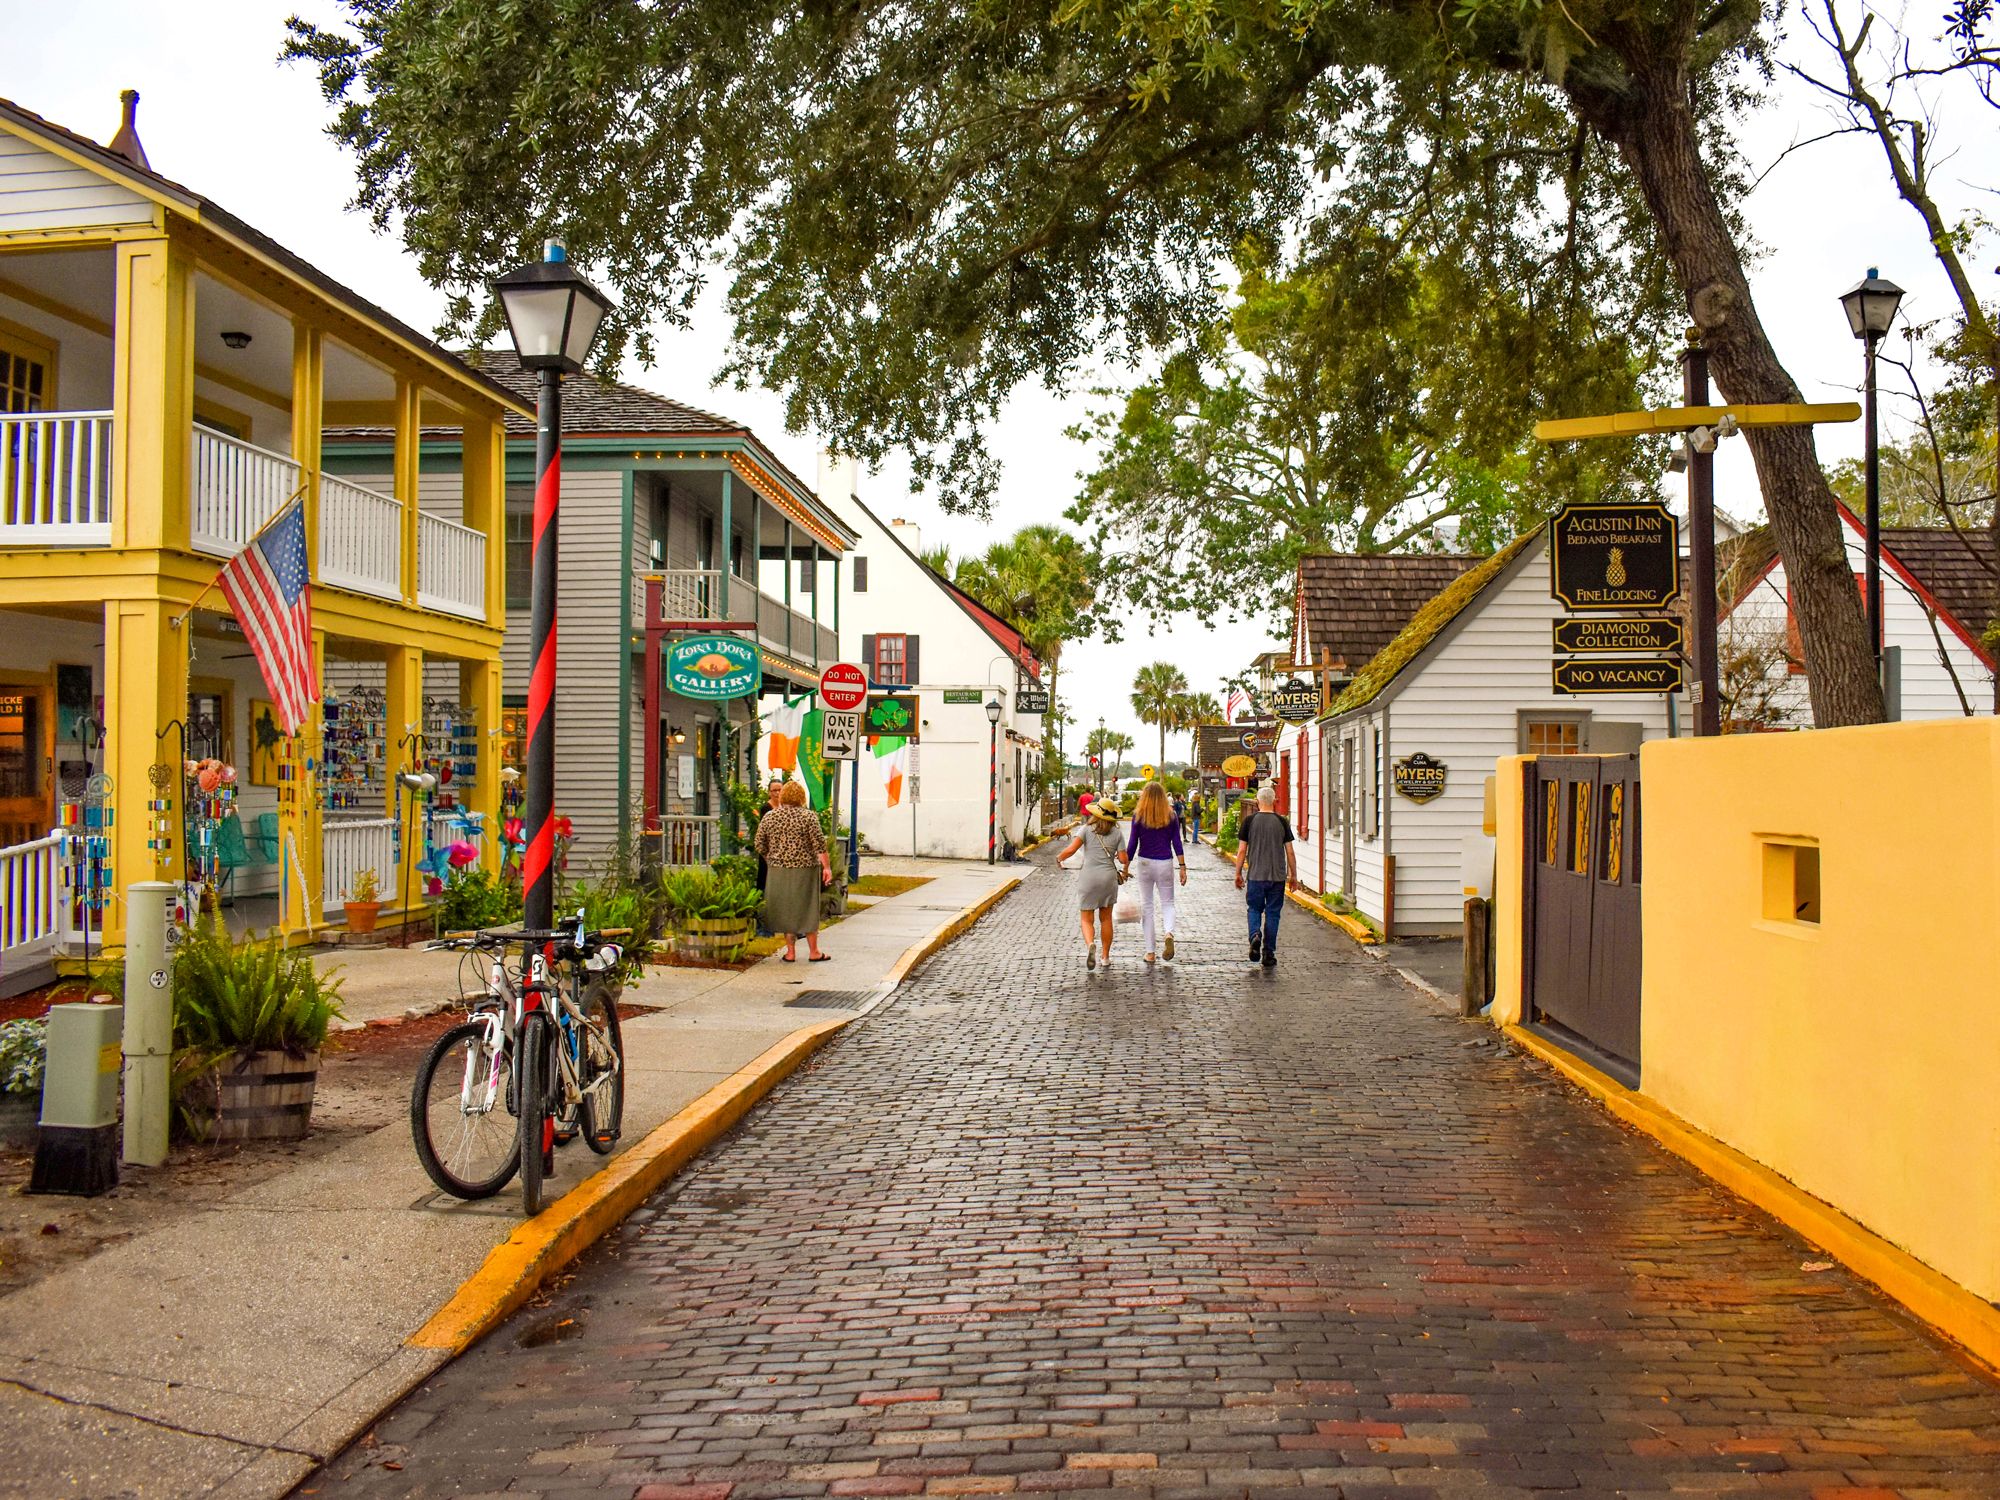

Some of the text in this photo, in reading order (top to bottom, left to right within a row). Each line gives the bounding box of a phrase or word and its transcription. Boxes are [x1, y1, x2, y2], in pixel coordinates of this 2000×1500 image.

[1567, 515, 1662, 532] AGUSTIN INN
[1568, 534, 1662, 544] BED AND BREAKFAST
[1576, 588, 1656, 600] FINE LODGING
[1582, 623, 1650, 634] DIAMOND
[1576, 636, 1660, 647] COLLECTION
[674, 673, 752, 688] GALLERY
[828, 671, 860, 680] DO NOT
[1571, 670, 1666, 682] NO VACANCY
[830, 692, 856, 702] ENTER
[1030, 694, 1048, 702] White
[1274, 692, 1318, 704] MYERS
[828, 716, 855, 728] ONE
[827, 728, 855, 740] WAY
[1396, 768, 1444, 780] MYERS
